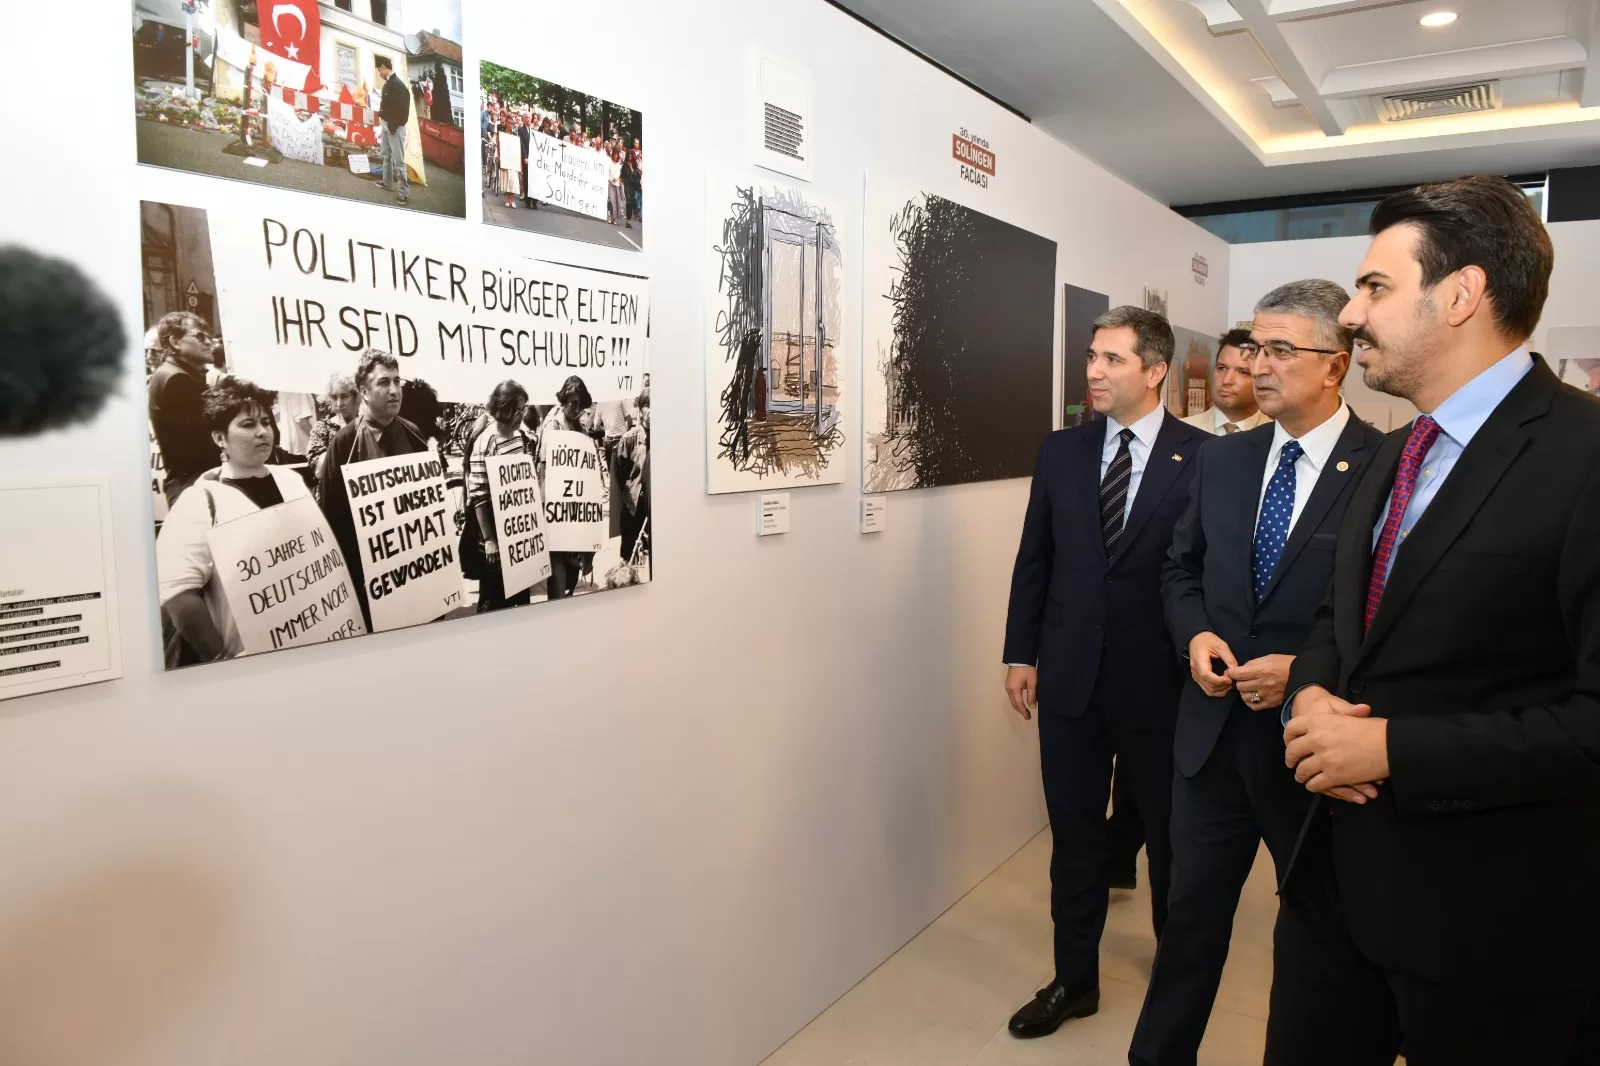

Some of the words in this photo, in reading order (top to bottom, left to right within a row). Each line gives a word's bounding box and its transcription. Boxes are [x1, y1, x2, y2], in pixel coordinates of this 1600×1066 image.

[532, 131, 557, 157] Wir
[537, 154, 550, 171] die
[546, 175, 598, 215] Solingen
[263, 218, 476, 314] POLITIKER,
[482, 268, 574, 325] BÜRGER,
[578, 287, 638, 326] ELTERN
[272, 295, 331, 348] IHR
[552, 444, 580, 468] HÖRT
[581, 450, 597, 471] AUF
[347, 460, 442, 499] DEUTSCHLAND
[499, 486, 536, 511] HÄRTER
[563, 480, 584, 498] ZU
[359, 501, 385, 527] IST
[393, 483, 445, 515] UNSERE
[503, 511, 539, 537] GEGEN
[546, 502, 603, 523] SCHWEIGEN
[236, 556, 261, 582] 30
[265, 535, 306, 568] JAHRE
[310, 527, 325, 548] IN
[368, 508, 446, 563] HEIMAT
[508, 533, 545, 567] RECHTS
[248, 548, 344, 615] DEUTSCHLAND,
[369, 544, 454, 600] GEWORDEN
[269, 603, 322, 650] IMMER
[320, 581, 349, 617] NOCH
